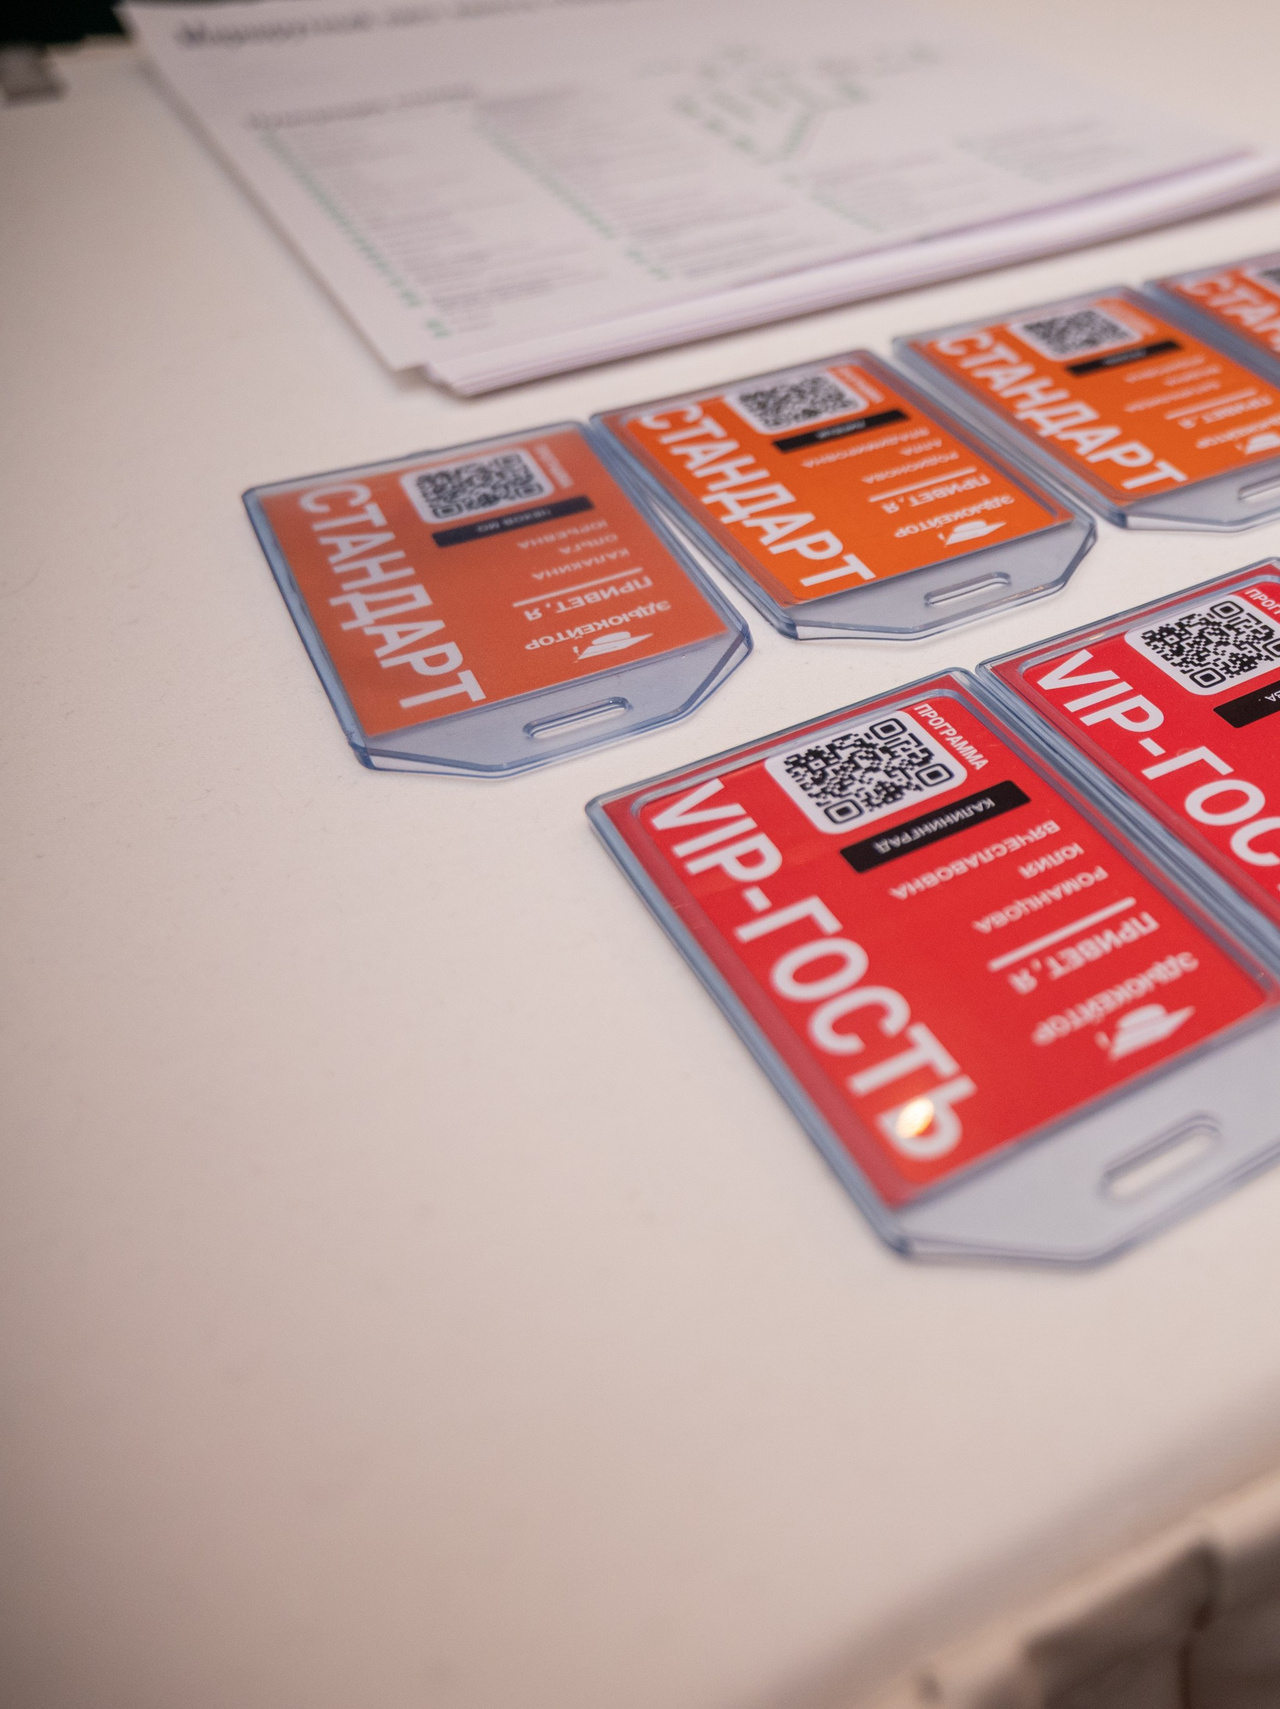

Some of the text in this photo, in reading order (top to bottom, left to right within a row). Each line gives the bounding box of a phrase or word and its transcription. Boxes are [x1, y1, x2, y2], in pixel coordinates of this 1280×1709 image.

[935, 332, 1187, 488] СТАНДАРТ
[641, 402, 877, 587] СТАНДАРТ
[517, 519, 609, 550] ЮРЬЕВНА
[531, 548, 631, 581] КАЛАКИНА
[559, 533, 619, 555] ОЛЬГА
[300, 481, 487, 709] СТАНДАРТ
[524, 576, 654, 622] ПРИВЕТ, Я
[524, 600, 672, 651] ЭДЬЮКЕЙТОР
[914, 703, 989, 771] ПРОГРАММА
[873, 797, 995, 854] КАЛИНИНГРАД
[889, 820, 1061, 899] ВЯЧЕСЛАВОВНА
[1017, 842, 1085, 879] ЮЛИЯ
[972, 866, 1108, 933] РОМАНЦОВА
[650, 778, 977, 1161] VIP-ГОСТЬ
[1008, 911, 1160, 994] ПРИВЕТ, Я
[1031, 952, 1199, 1045] ЭДЬЮКЕЙТОР
